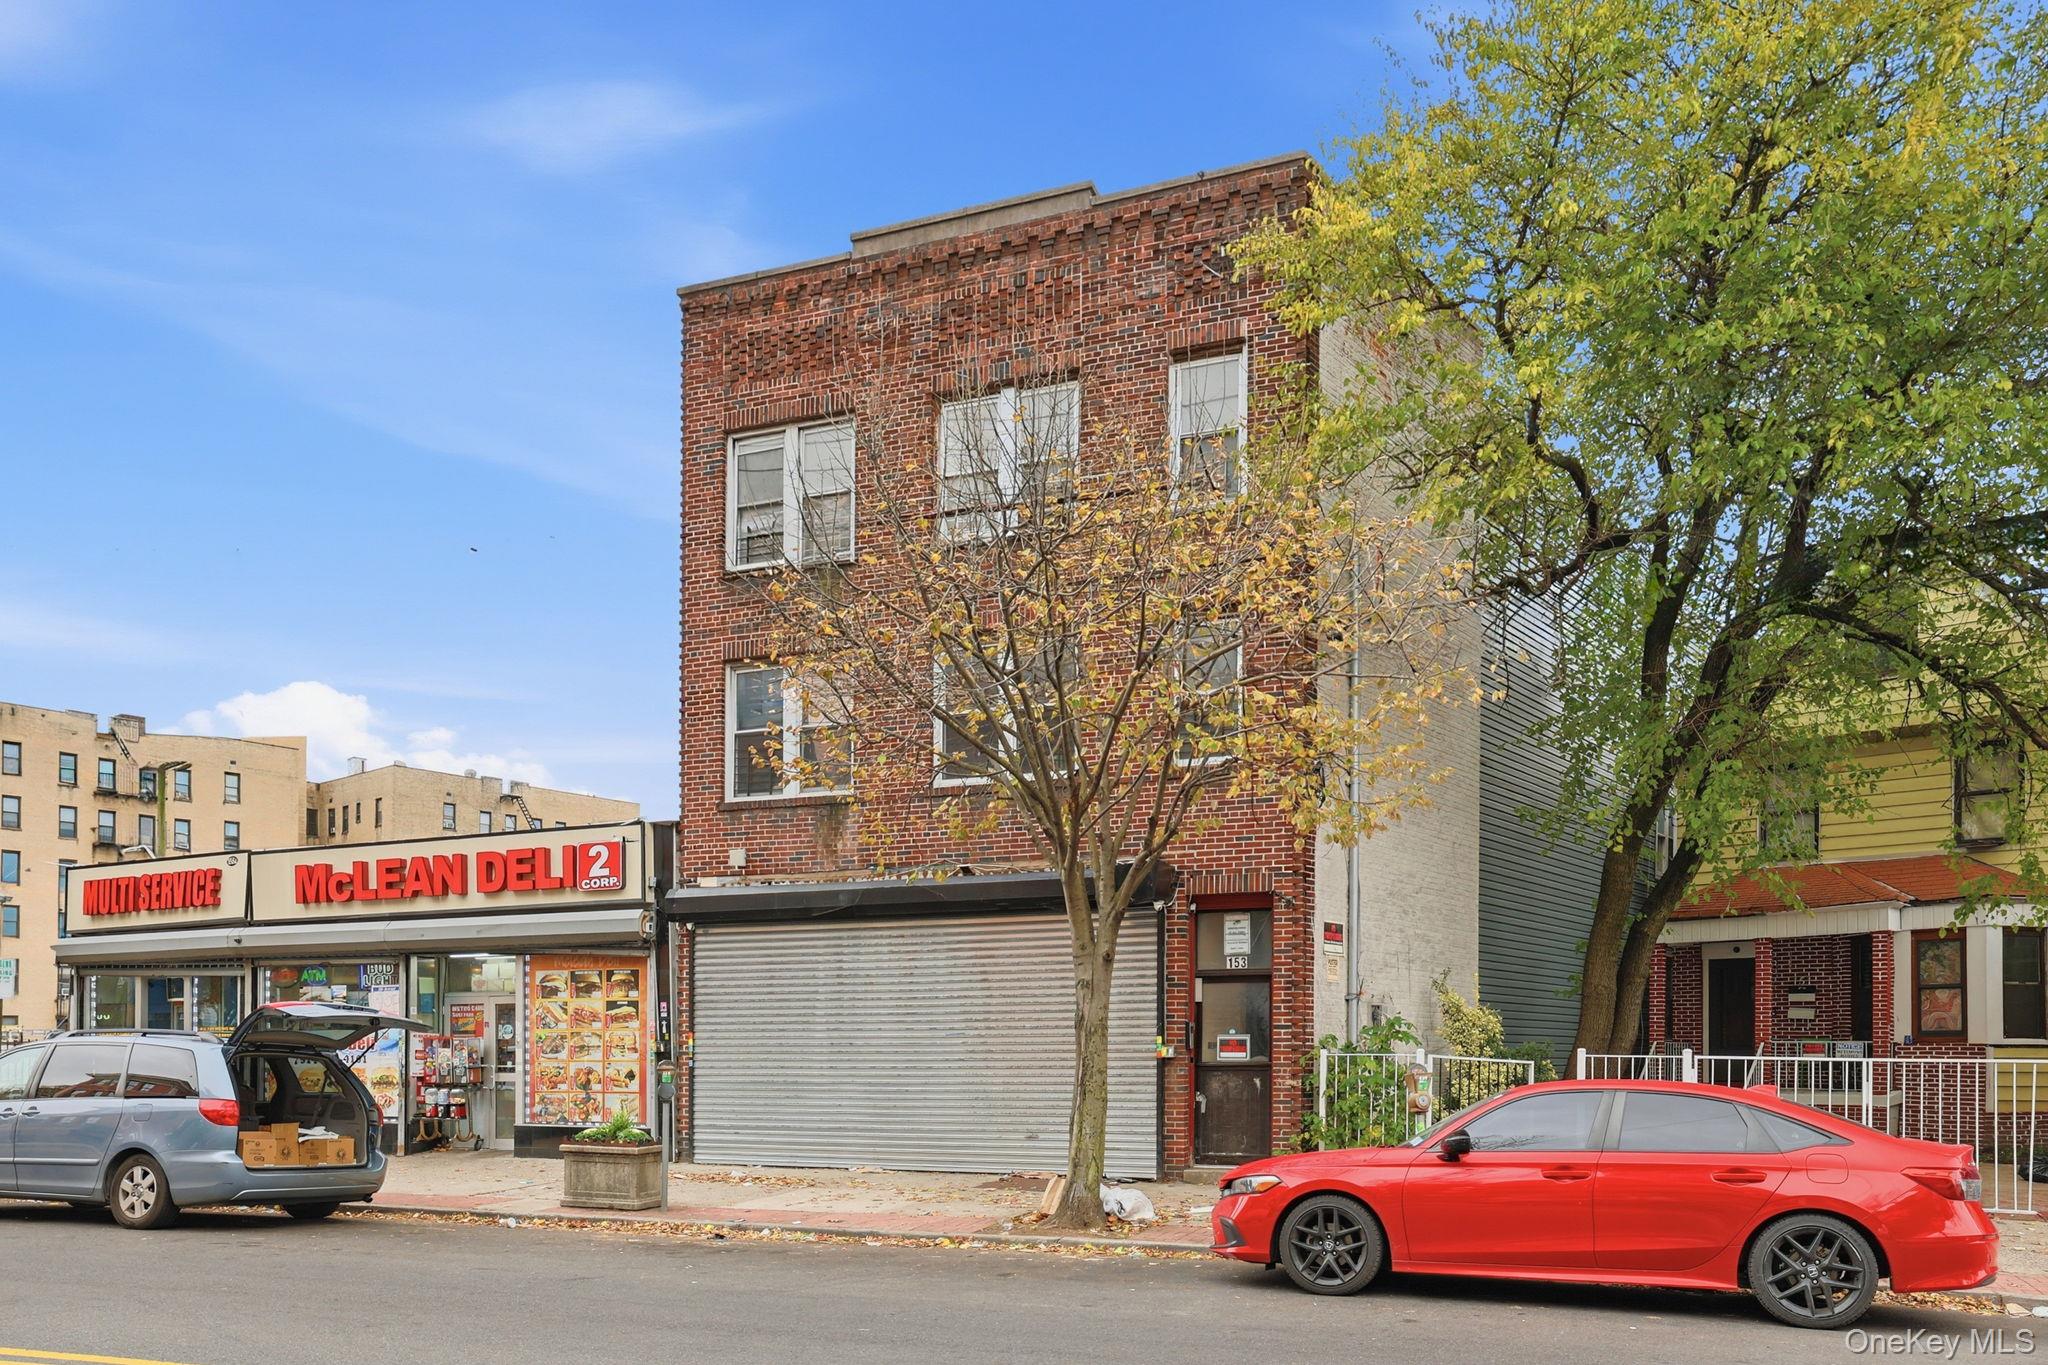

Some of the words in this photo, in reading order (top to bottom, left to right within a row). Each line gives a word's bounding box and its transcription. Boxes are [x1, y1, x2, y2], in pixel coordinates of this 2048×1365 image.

[588, 844, 610, 878] 2
[295, 853, 468, 904] McLEAN
[476, 845, 577, 894] DELI
[581, 877, 621, 889] CORP.
[83, 876, 140, 916] MULTI
[138, 868, 222, 911] SERVICE
[1228, 957, 1247, 968] 153
[301, 969, 327, 982] ATM
[367, 964, 394, 975] BUD
[364, 975, 399, 986] LIGHT
